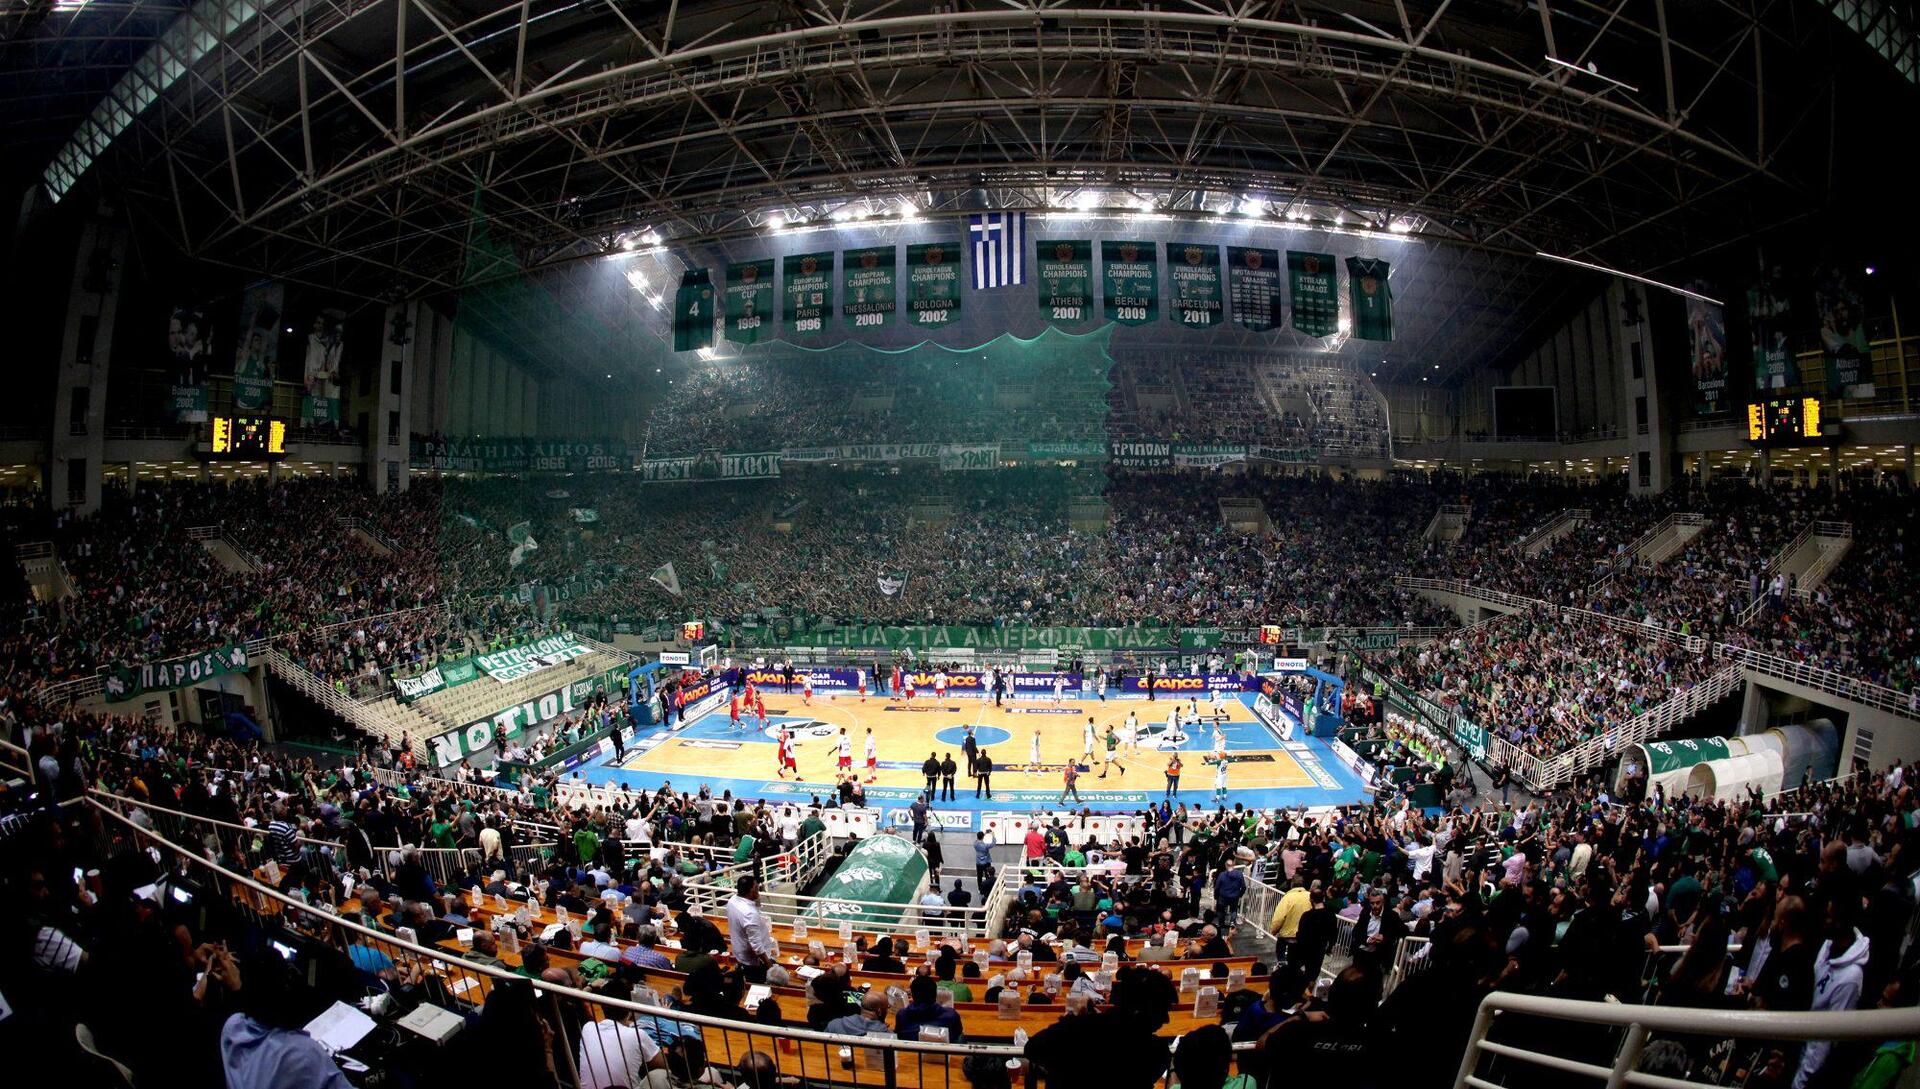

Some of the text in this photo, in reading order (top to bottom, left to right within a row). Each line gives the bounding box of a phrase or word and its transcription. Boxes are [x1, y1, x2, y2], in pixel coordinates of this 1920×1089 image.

[911, 272, 956, 282] CHAMPIONS
[1043, 270, 1087, 279] CHAMPIONS
[1107, 270, 1152, 279] CHAMPIONS
[1173, 272, 1216, 282] CHAMPIONS
[787, 281, 829, 294] CHAMPIONS
[848, 276, 891, 288] CHAMPIONS
[913, 299, 954, 310] BOLOGNA
[1050, 297, 1084, 306] ATHENS
[1115, 297, 1149, 306] BERLIN
[1171, 298, 1221, 310] BARCELONA
[688, 301, 700, 317] 4
[796, 308, 820, 318] PARIS
[845, 302, 896, 314] THESSALONIKI
[1053, 306, 1081, 320] 2007
[1117, 307, 1146, 320] 2009
[855, 313, 884, 327] 2000
[919, 309, 948, 323] 2002
[1183, 310, 1211, 324] 2011
[737, 316, 761, 330] 1996
[795, 318, 821, 332] 1996
[643, 459, 694, 480] WEST
[721, 455, 781, 477] BLOCK
[1266, 634, 1279, 644] 24
[141, 653, 214, 688] ΠΑΡΟΣ
